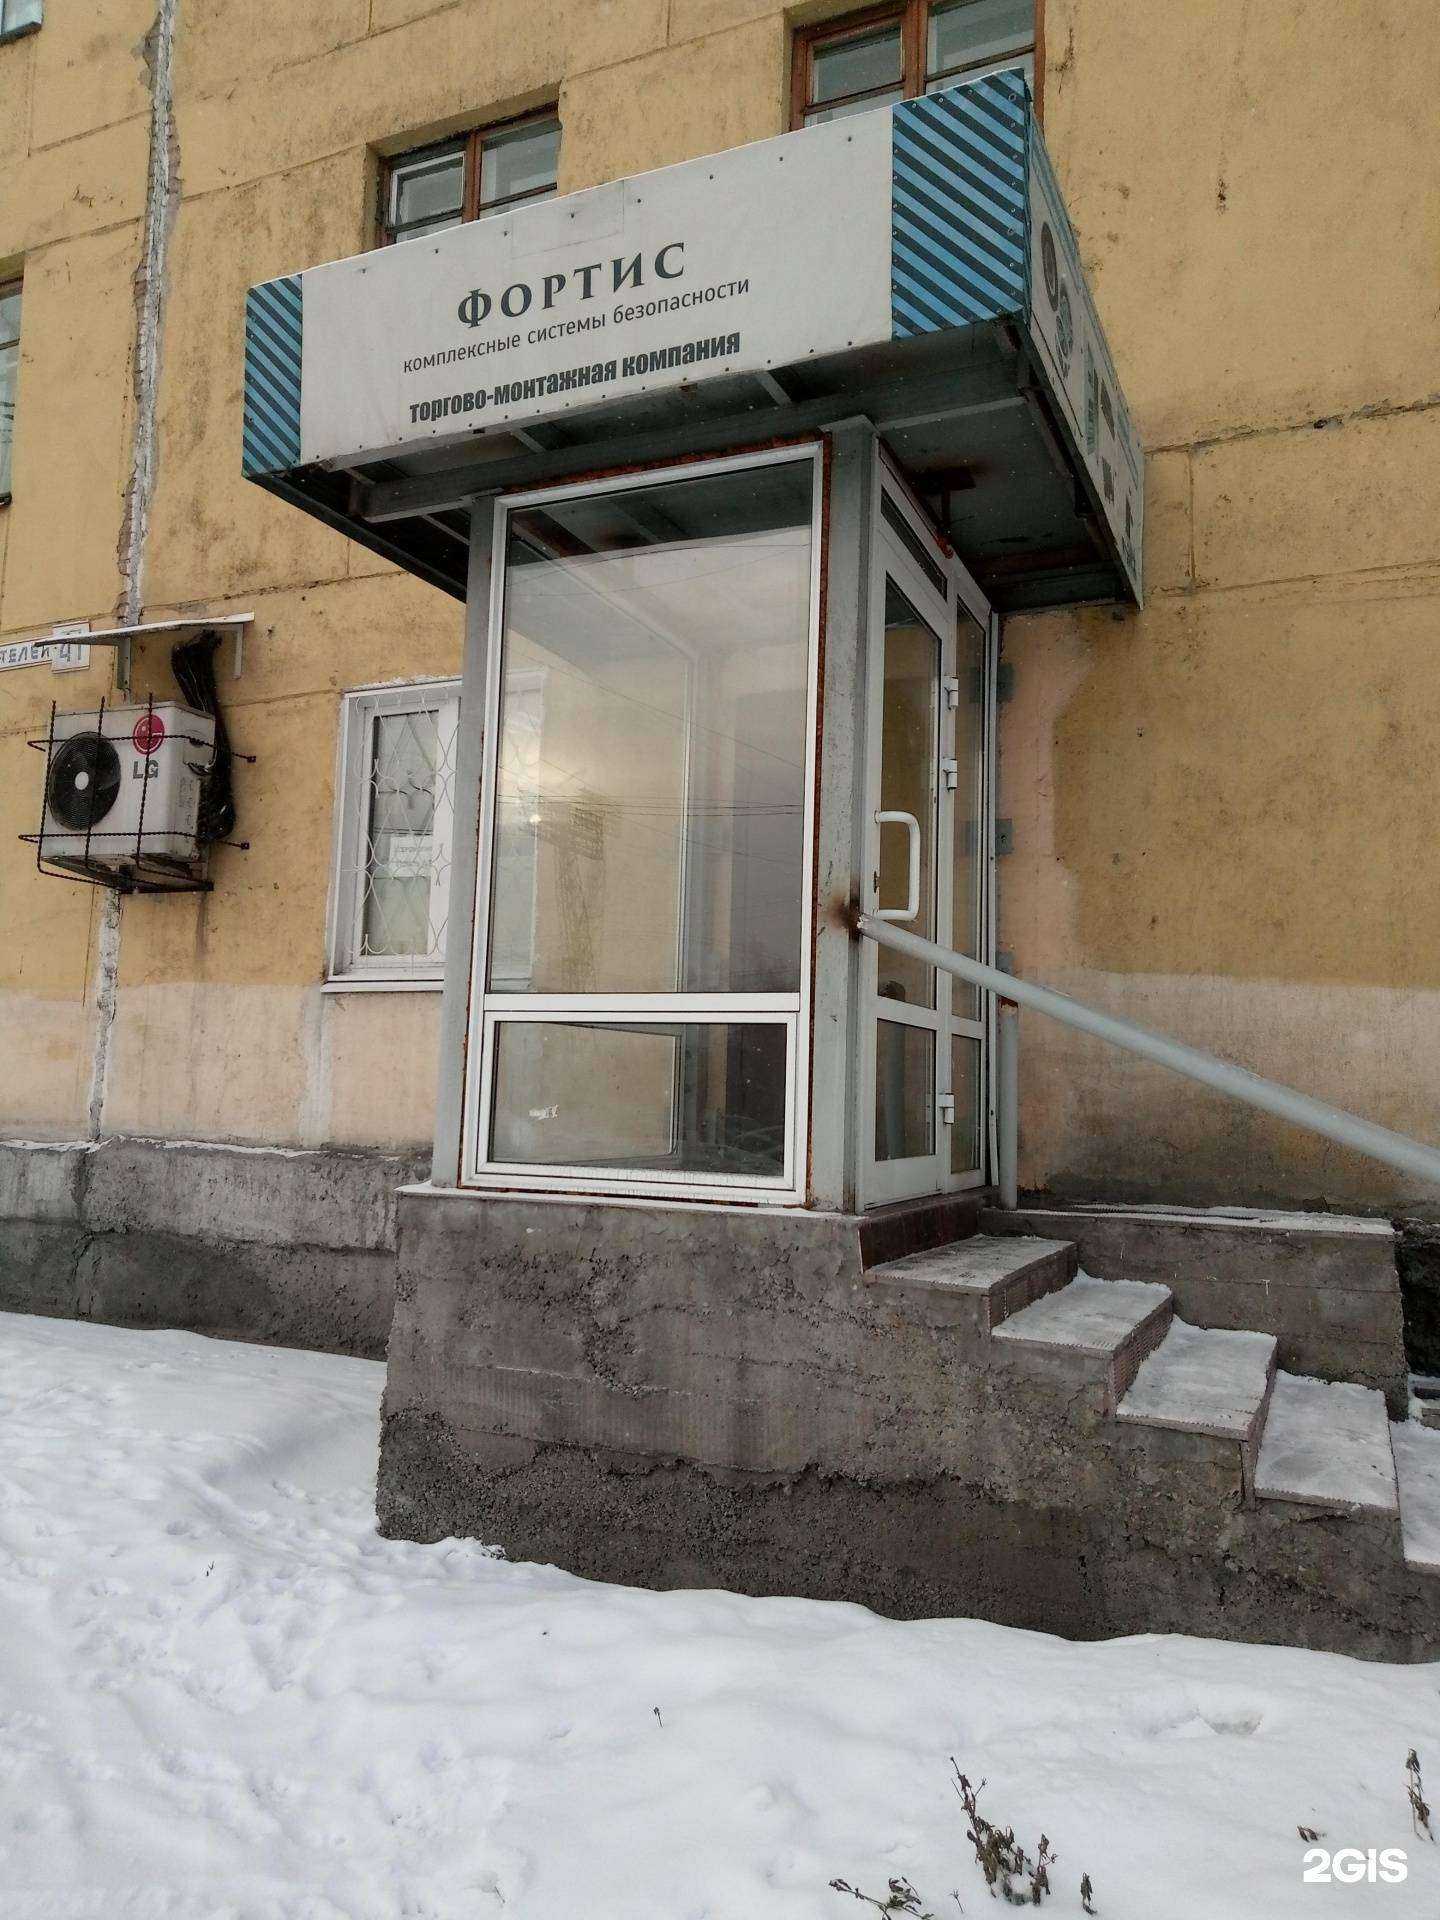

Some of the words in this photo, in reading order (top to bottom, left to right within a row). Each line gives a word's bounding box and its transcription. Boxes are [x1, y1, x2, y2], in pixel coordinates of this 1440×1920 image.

[403, 332, 521, 374] комплексные
[527, 310, 606, 345] системы
[613, 278, 750, 325] безопасности
[457, 241, 686, 330] ФОРТИС
[409, 359, 617, 424] торгово-монтажная
[622, 331, 741, 379] компания
[132, 759, 159, 780] LG
